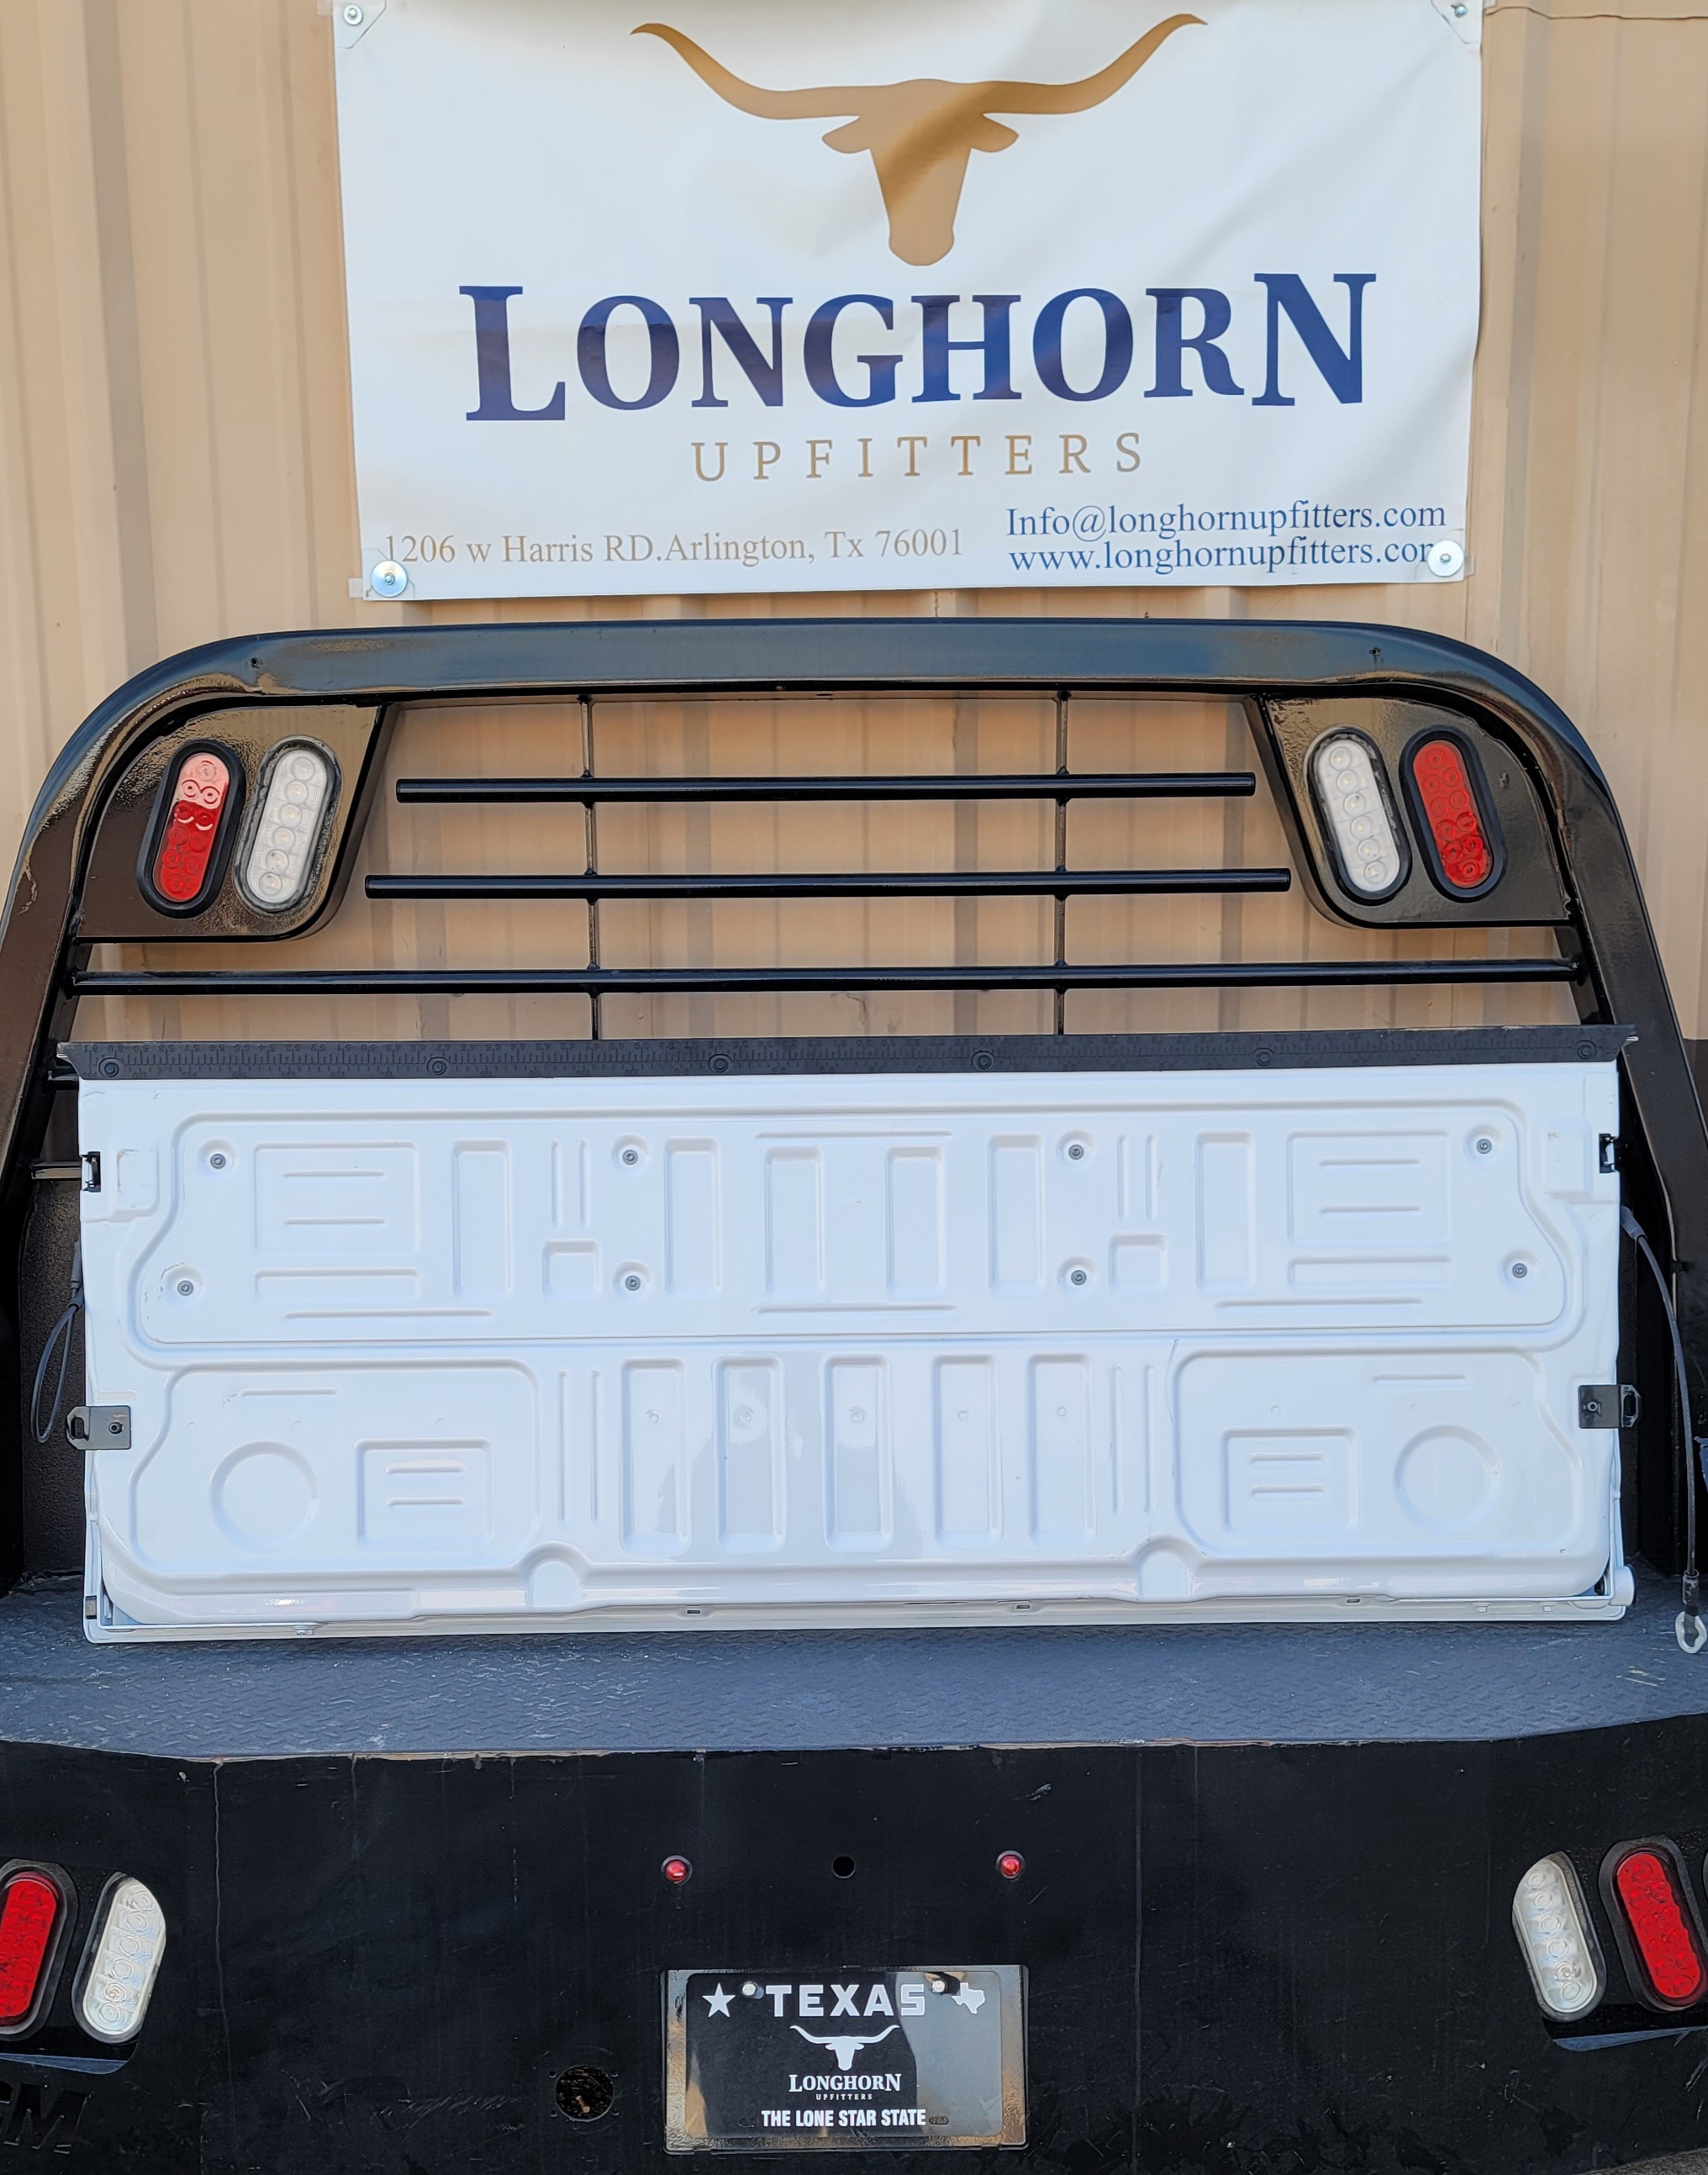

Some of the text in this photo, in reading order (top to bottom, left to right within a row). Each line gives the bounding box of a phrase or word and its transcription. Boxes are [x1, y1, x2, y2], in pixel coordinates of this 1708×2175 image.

[459, 273, 1376, 421] LONGHORN
[691, 432, 1141, 482] UPFITTERS
[1006, 500, 1447, 542] Info@longhornupfitters.com
[385, 535, 456, 562] 1206
[466, 543, 492, 563] w
[501, 535, 593, 563] Harris
[825, 531, 864, 559] Tx
[874, 528, 962, 558] 76001
[766, 1983, 925, 2017] TEXAS
[788, 2073, 902, 2092] LONGHORN
[815, 2093, 872, 2101] UPFITTERS
[761, 2109, 926, 2128] THE LONE STAR STATE
